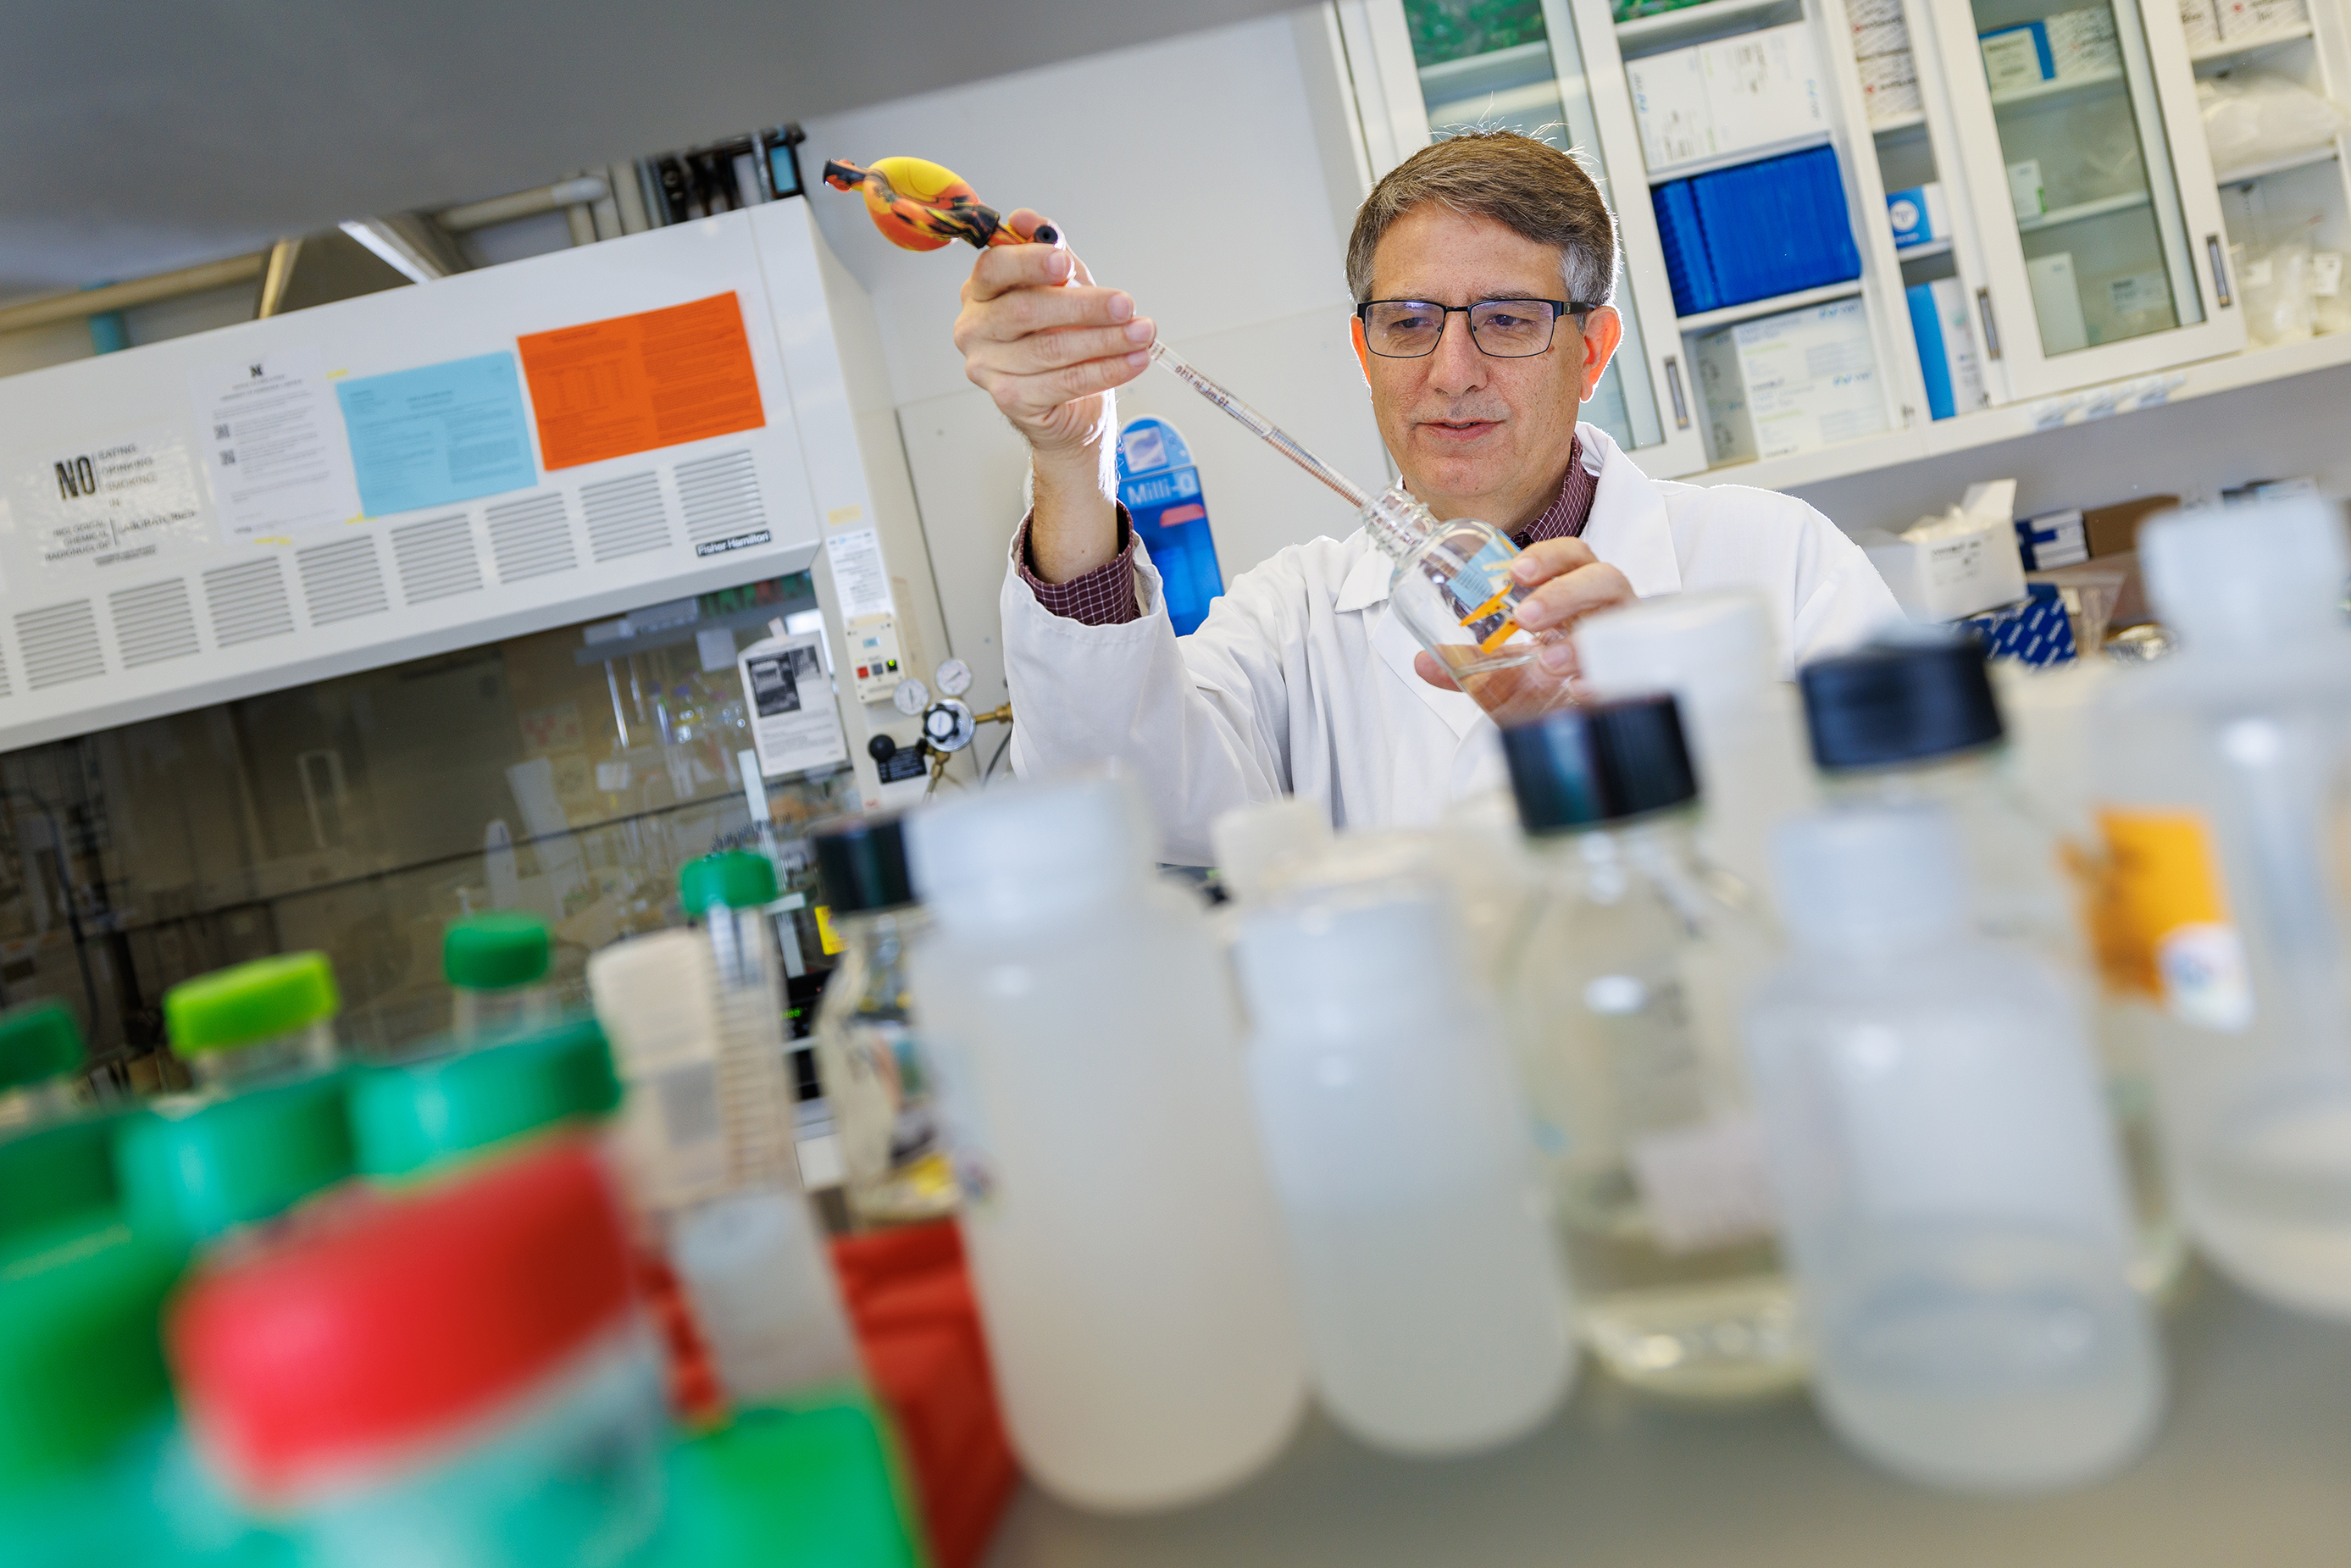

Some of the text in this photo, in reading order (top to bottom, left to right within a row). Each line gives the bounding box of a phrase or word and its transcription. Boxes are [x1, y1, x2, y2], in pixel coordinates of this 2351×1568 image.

[97, 444, 136, 460] EATING
[101, 457, 153, 476] DRINKING
[54, 456, 96, 499] NO
[105, 473, 155, 491] SMOKING
[1127, 474, 1195, 505] Milli-Q
[110, 498, 120, 507] IN
[53, 519, 106, 537] BIOLOGICAL
[119, 510, 196, 534] LABORATORIES
[64, 531, 109, 546] CHEMICAL
[698, 532, 768, 556] Fisher Hamilton
[45, 540, 111, 561] RADIONUCLIDE
